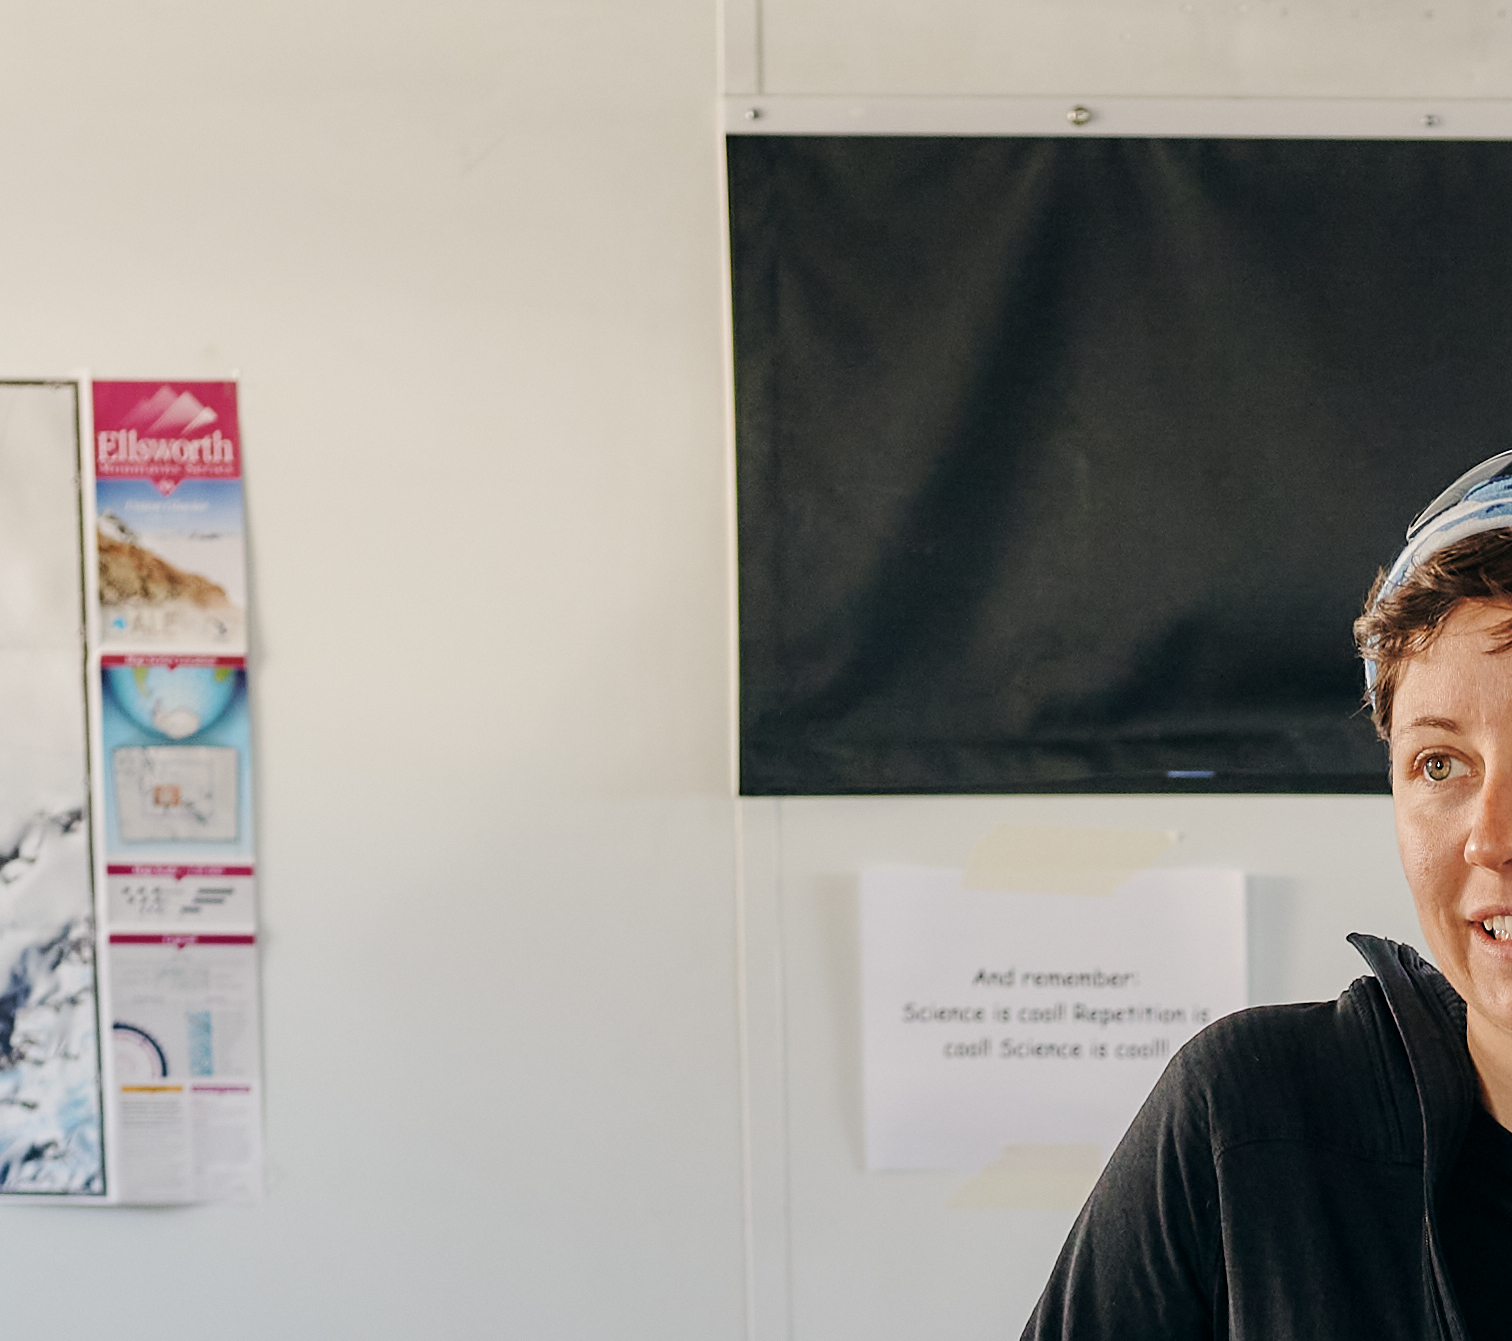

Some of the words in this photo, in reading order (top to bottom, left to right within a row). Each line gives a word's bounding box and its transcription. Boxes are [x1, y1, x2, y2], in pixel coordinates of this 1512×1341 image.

[97, 428, 234, 465] Ellsworth
[972, 968, 1015, 987] And
[902, 1002, 985, 1023] Science
[992, 1003, 1011, 1023] is
[1072, 1003, 1186, 1028] Repetition
[998, 1037, 1082, 1059] Science
[1090, 1038, 1109, 1059] is
